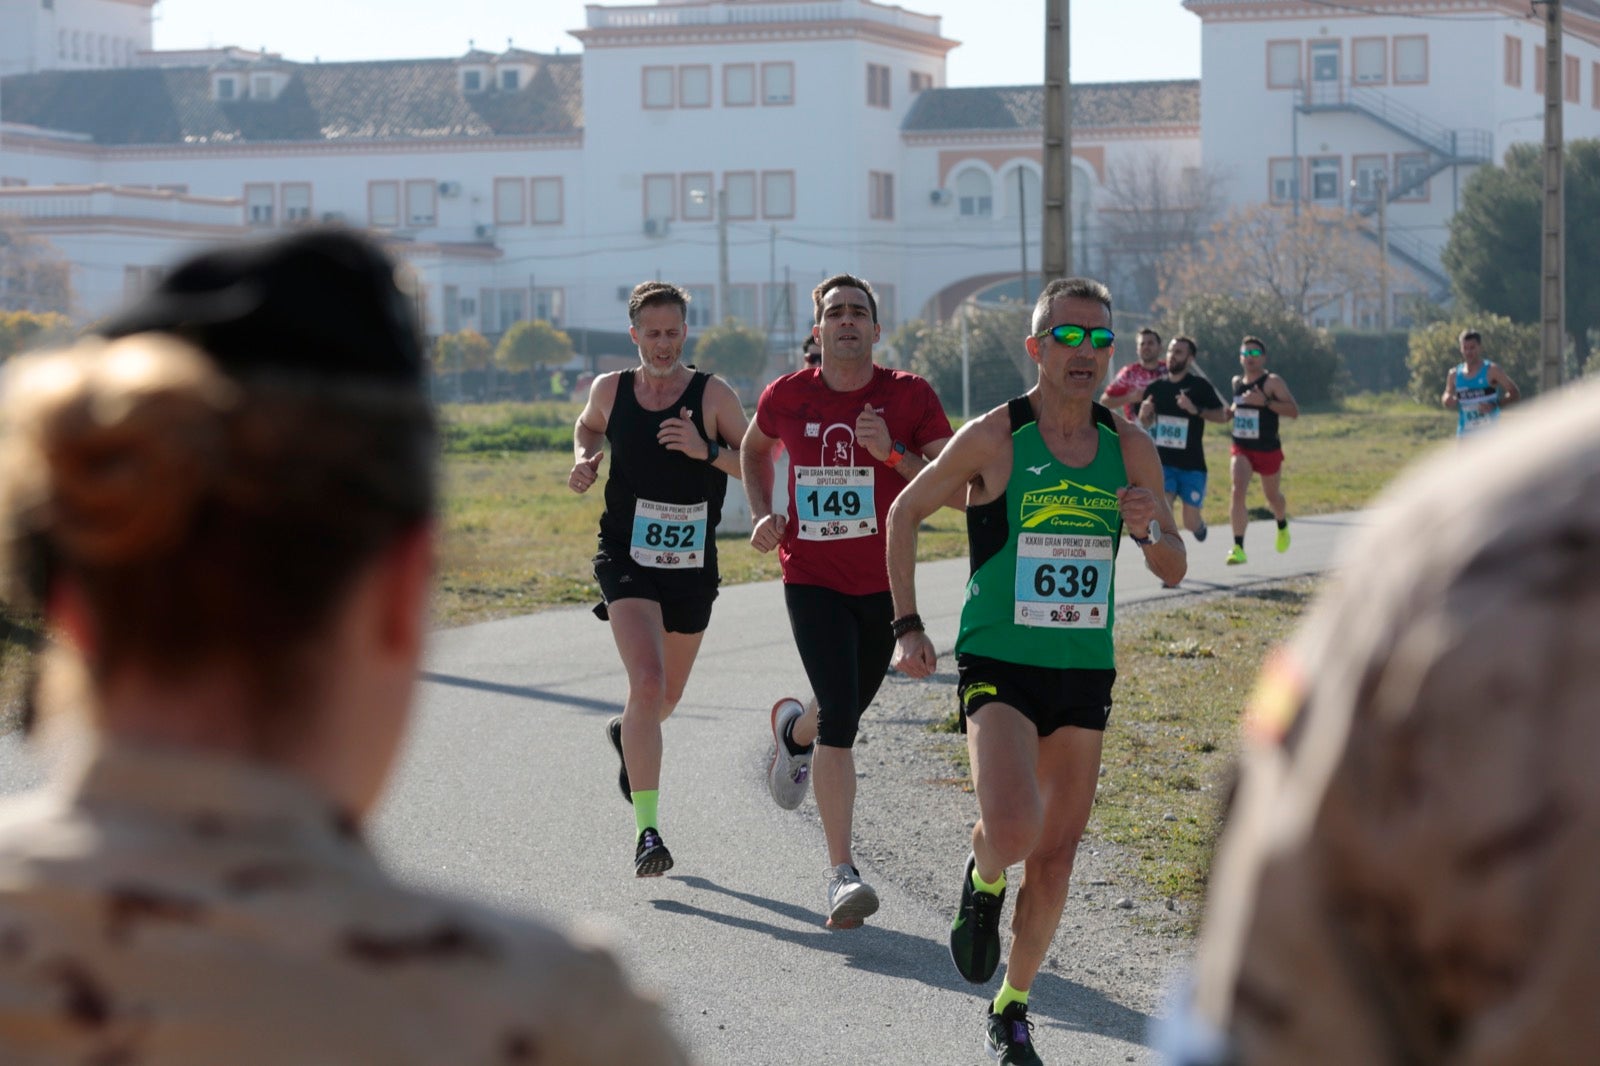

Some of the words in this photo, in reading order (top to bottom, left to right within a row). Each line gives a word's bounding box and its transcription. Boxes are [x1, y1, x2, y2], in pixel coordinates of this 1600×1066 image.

[1160, 425, 1182, 438] 968
[810, 468, 824, 476] GRAN
[825, 468, 844, 476] PREMIO
[845, 468, 851, 476] DE
[852, 468, 869, 477] FOO
[807, 490, 861, 517] 149
[1023, 494, 1078, 505] PUENTE
[655, 503, 669, 512] GRAN
[669, 505, 687, 513] PREMIO
[1050, 516, 1095, 528] Granada
[645, 523, 696, 548] 852
[1044, 536, 1061, 548] GRAN
[1063, 537, 1082, 548] PREMIO
[1084, 538, 1091, 548] DE
[1092, 538, 1111, 548] FONDO
[1034, 564, 1099, 598] 639
